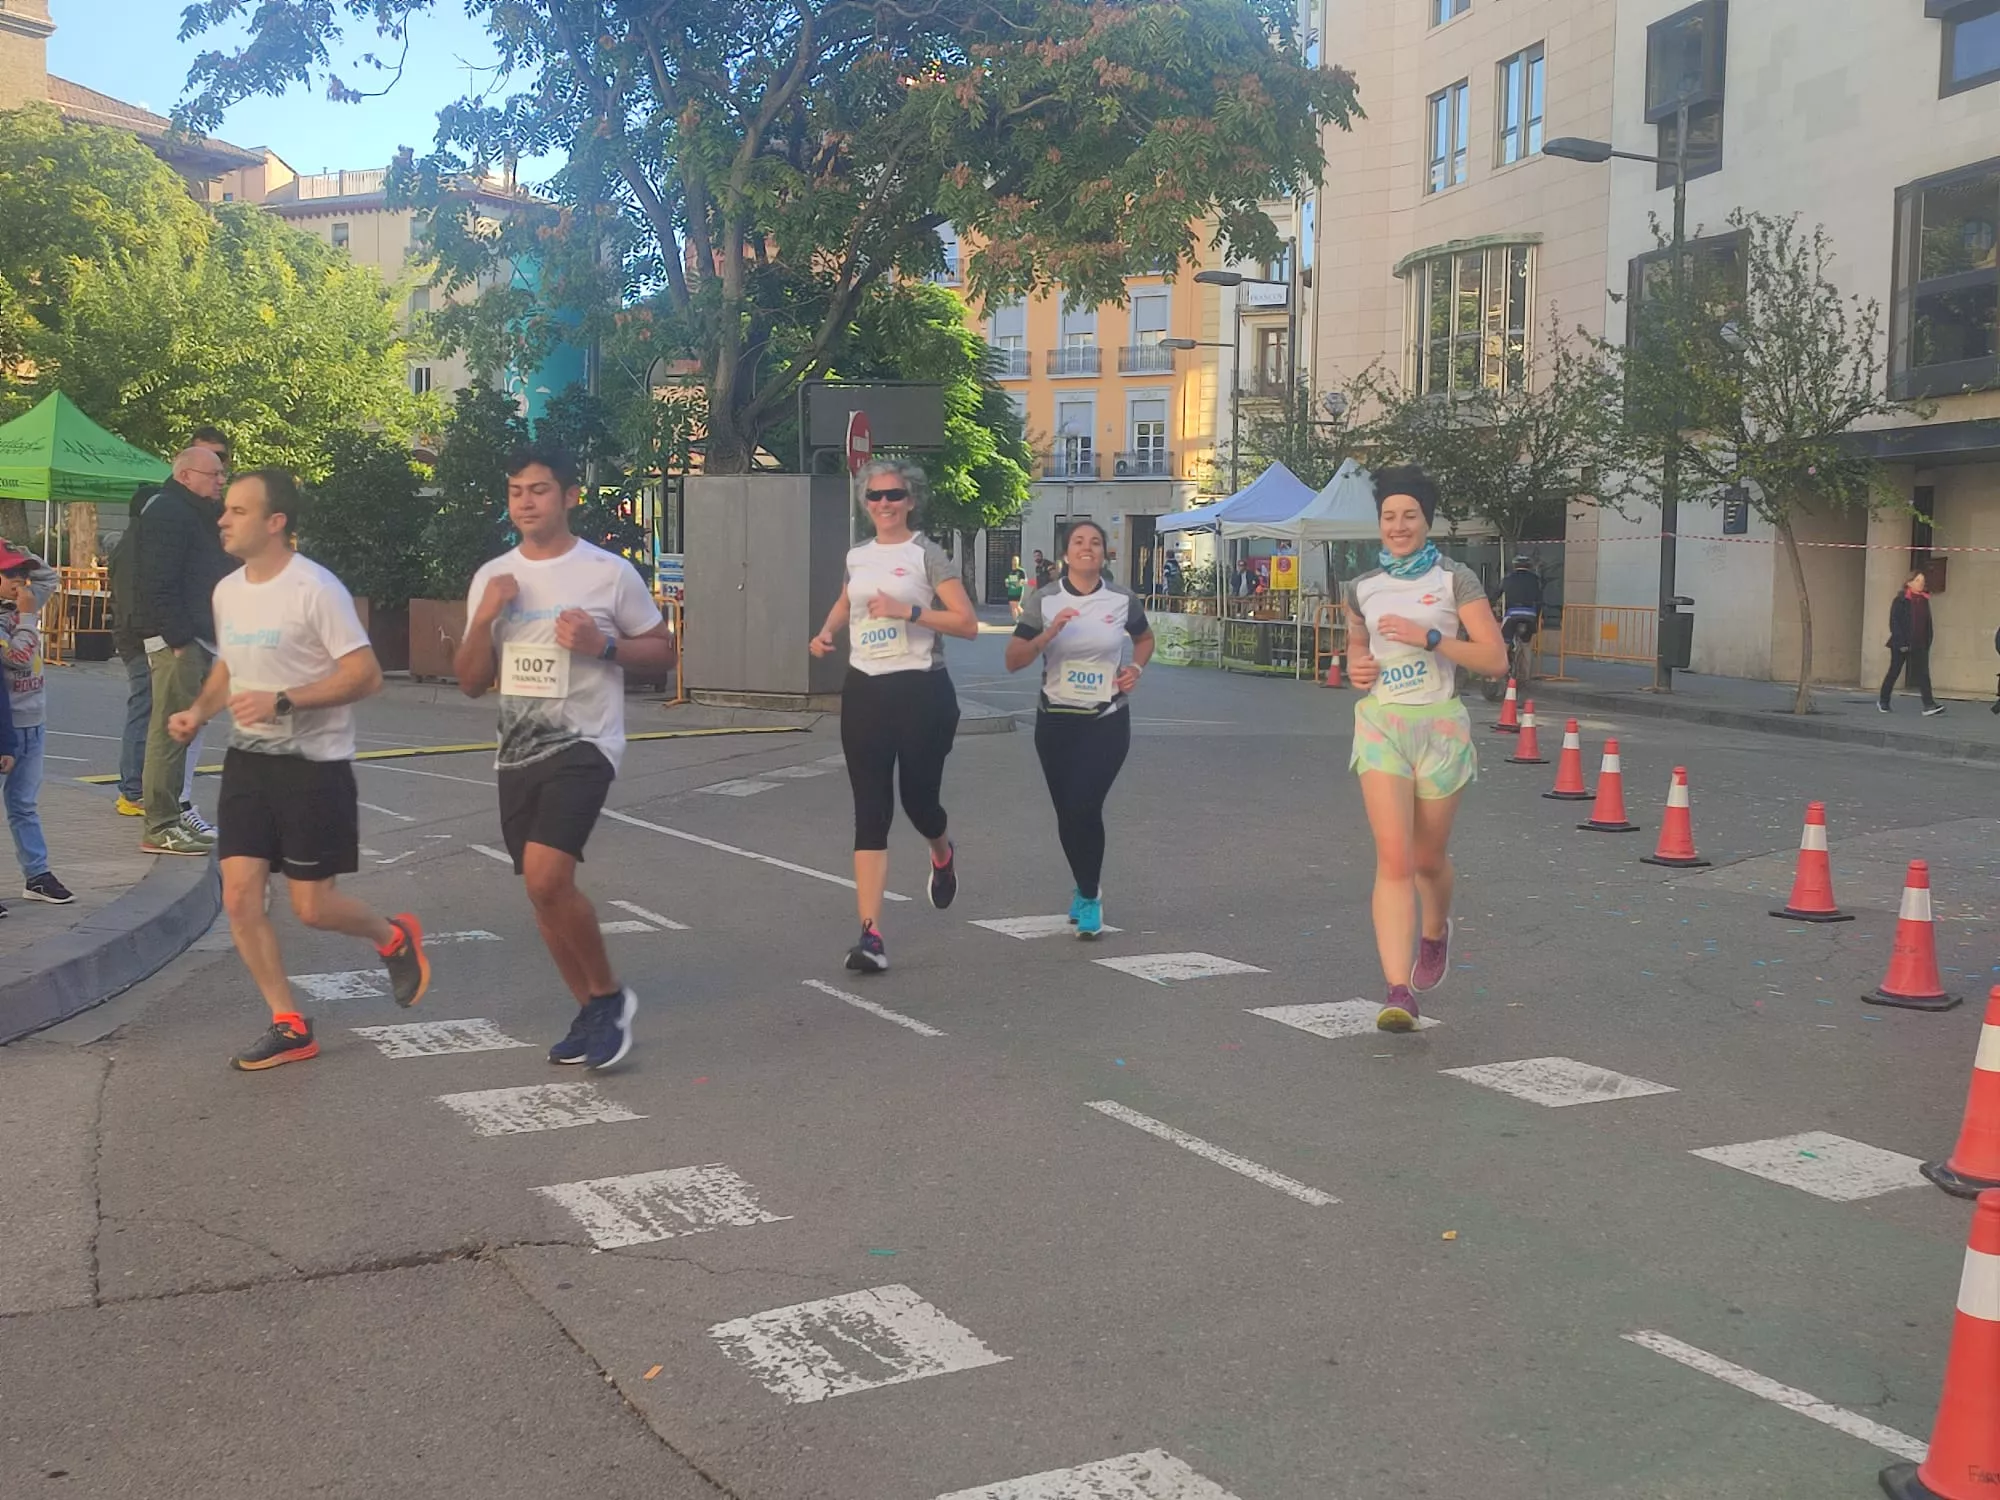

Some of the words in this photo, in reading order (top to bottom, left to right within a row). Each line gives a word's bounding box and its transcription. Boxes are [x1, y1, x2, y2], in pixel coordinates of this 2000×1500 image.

[861, 627, 897, 645] 2000
[514, 658, 556, 673] 1007
[1381, 661, 1427, 685] 2002
[1068, 671, 1104, 685] 2001
